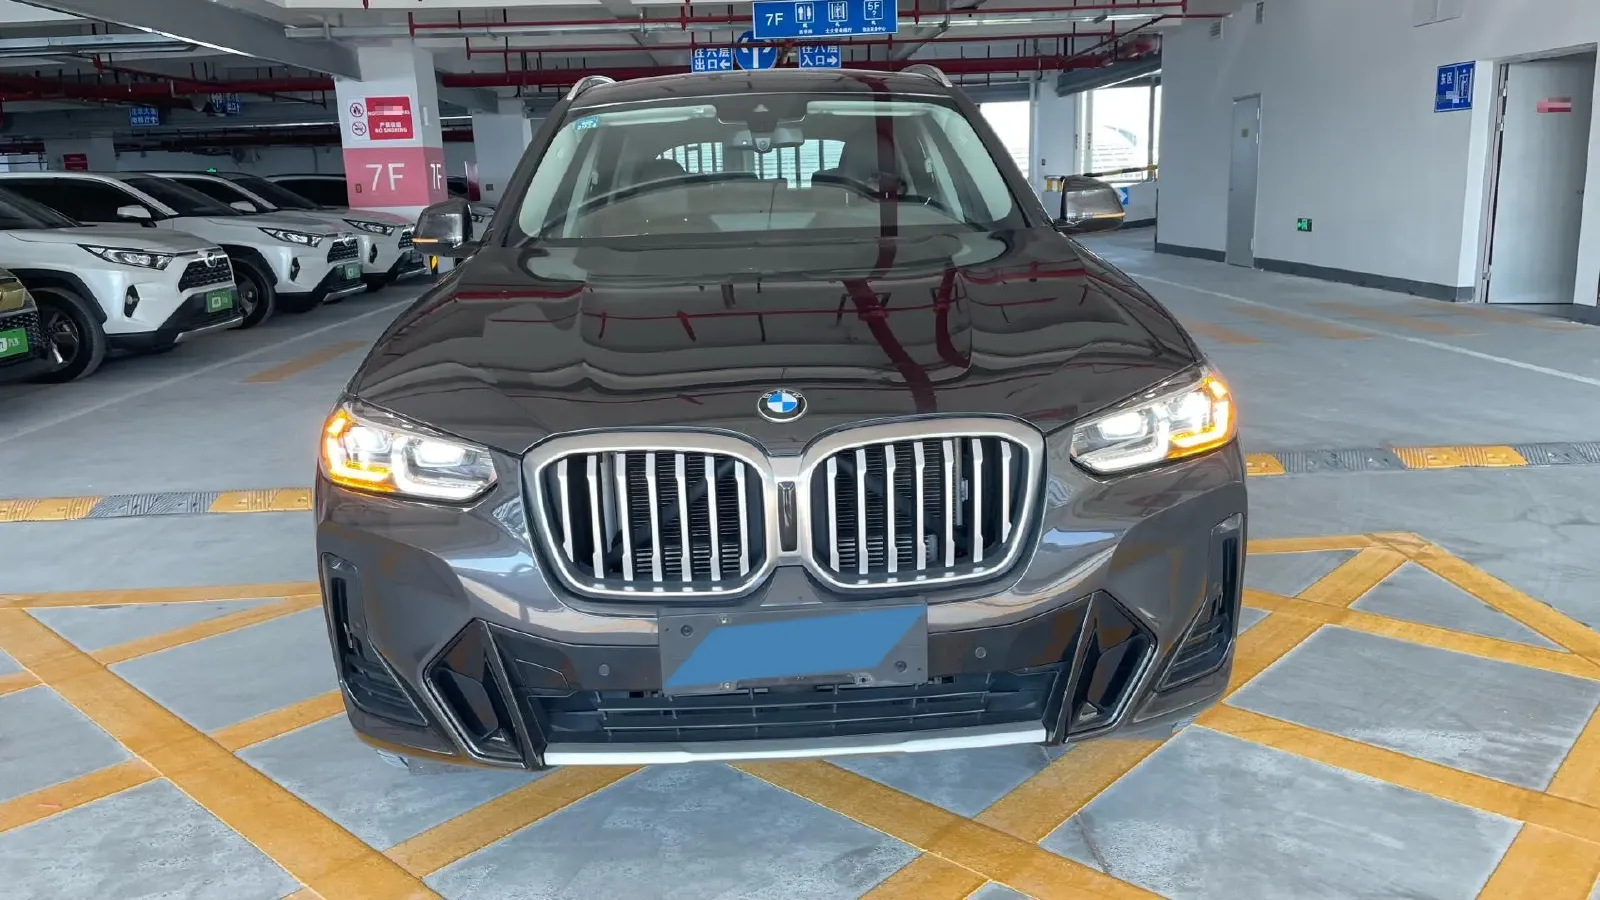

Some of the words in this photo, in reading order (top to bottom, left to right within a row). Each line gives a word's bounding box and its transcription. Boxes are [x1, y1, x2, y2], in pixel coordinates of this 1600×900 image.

[867, 1, 881, 10] 5F
[765, 12, 784, 26] 7F
[694, 58, 718, 71] 出口
[801, 54, 825, 66] 入口
[365, 163, 405, 191] 7F
